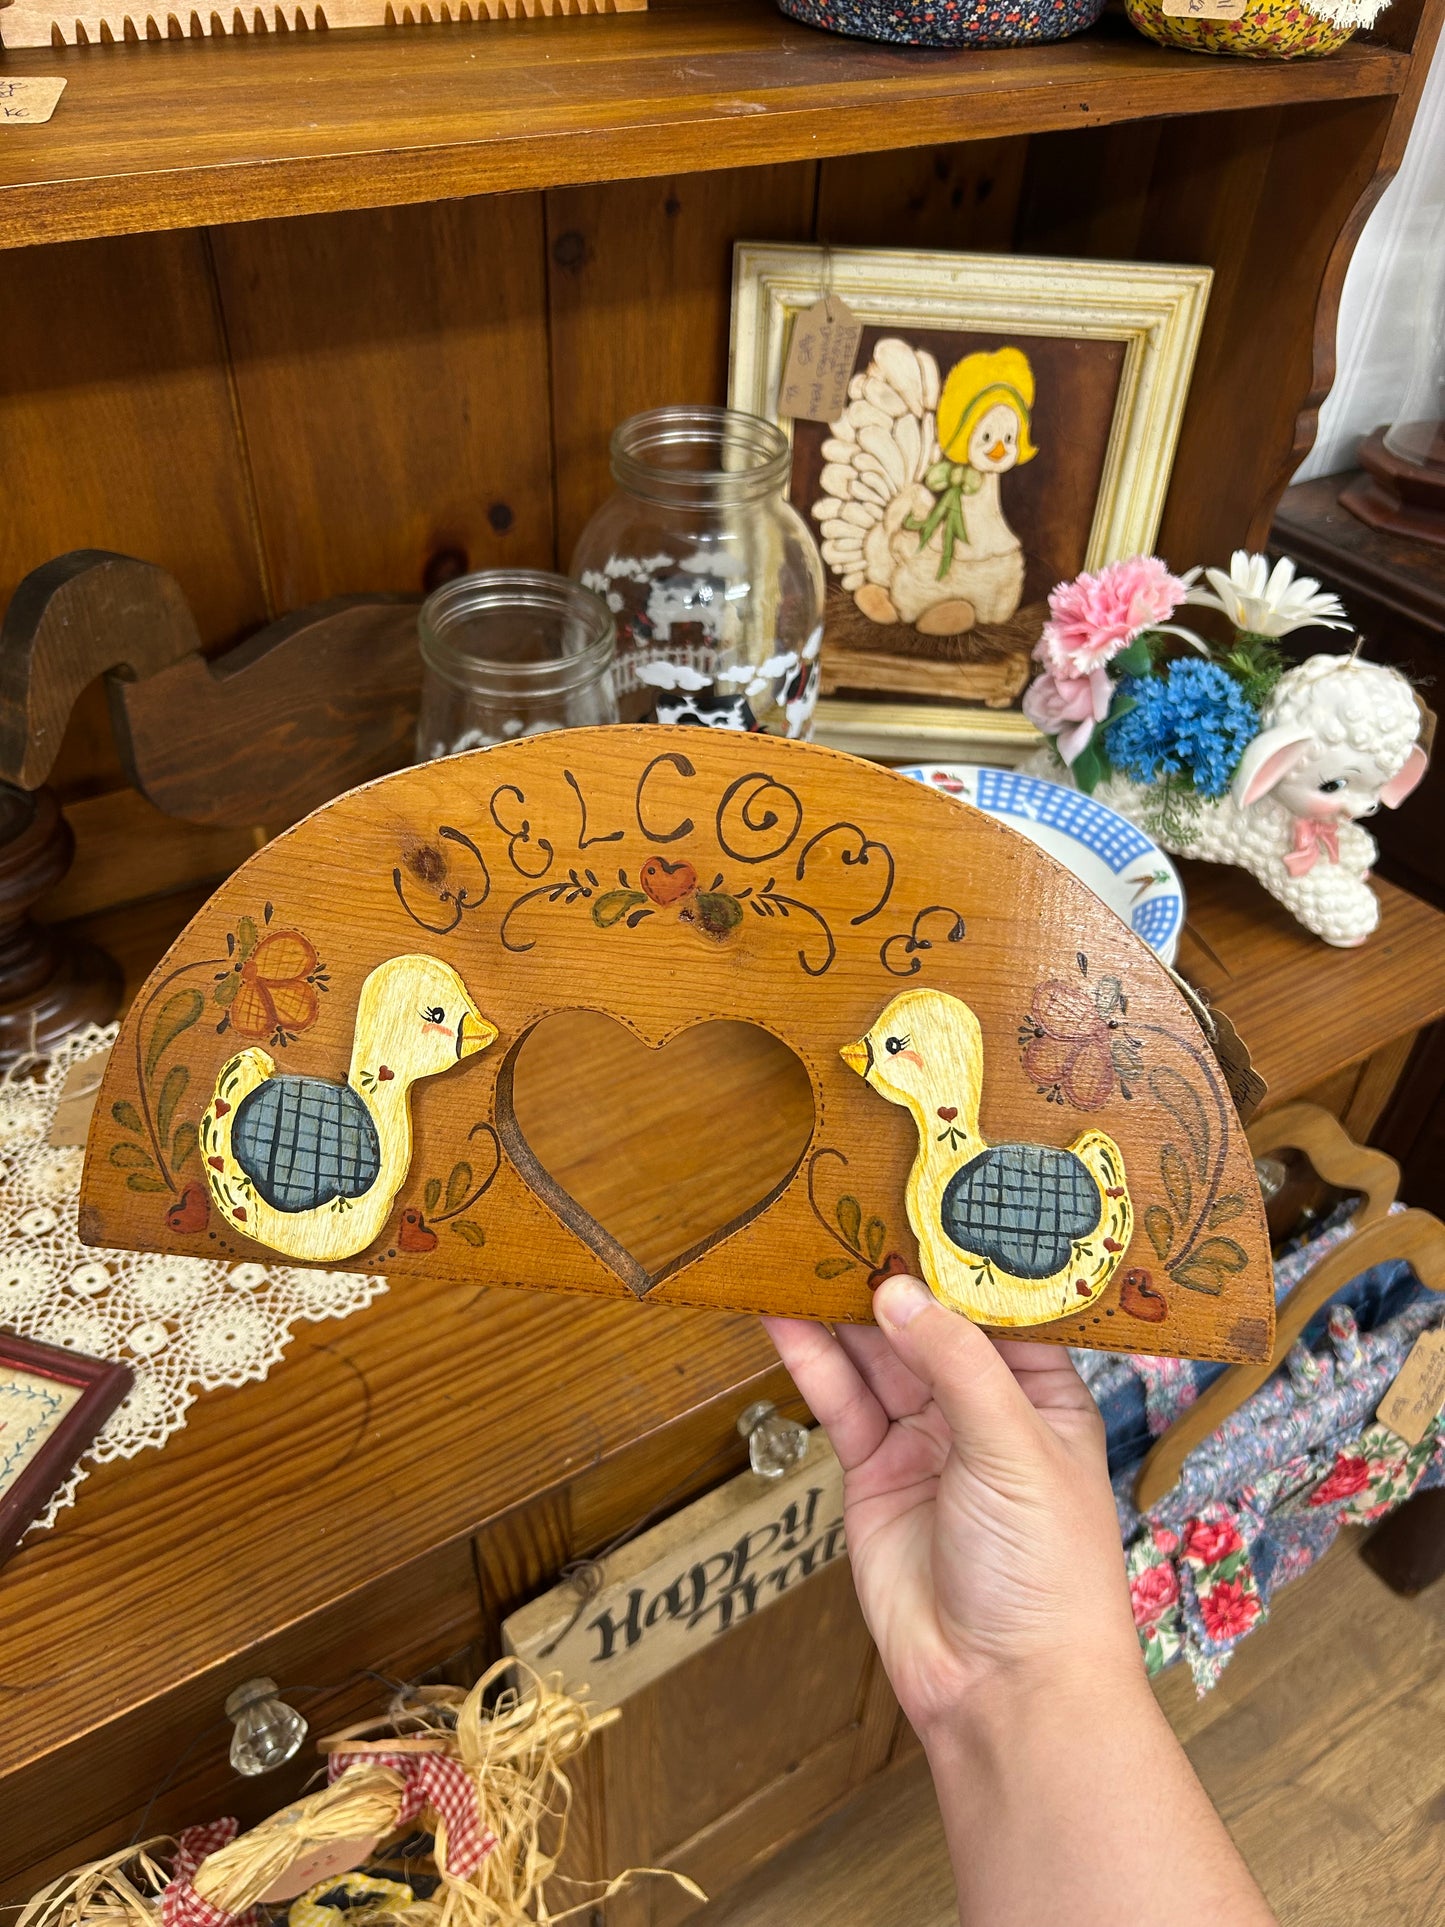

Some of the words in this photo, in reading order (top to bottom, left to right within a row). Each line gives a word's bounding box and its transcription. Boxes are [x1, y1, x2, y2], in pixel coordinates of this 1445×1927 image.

[392, 752, 966, 976] WELCOME
[585, 1487, 825, 1663] Happy
[685, 1517, 848, 1636] Trai
